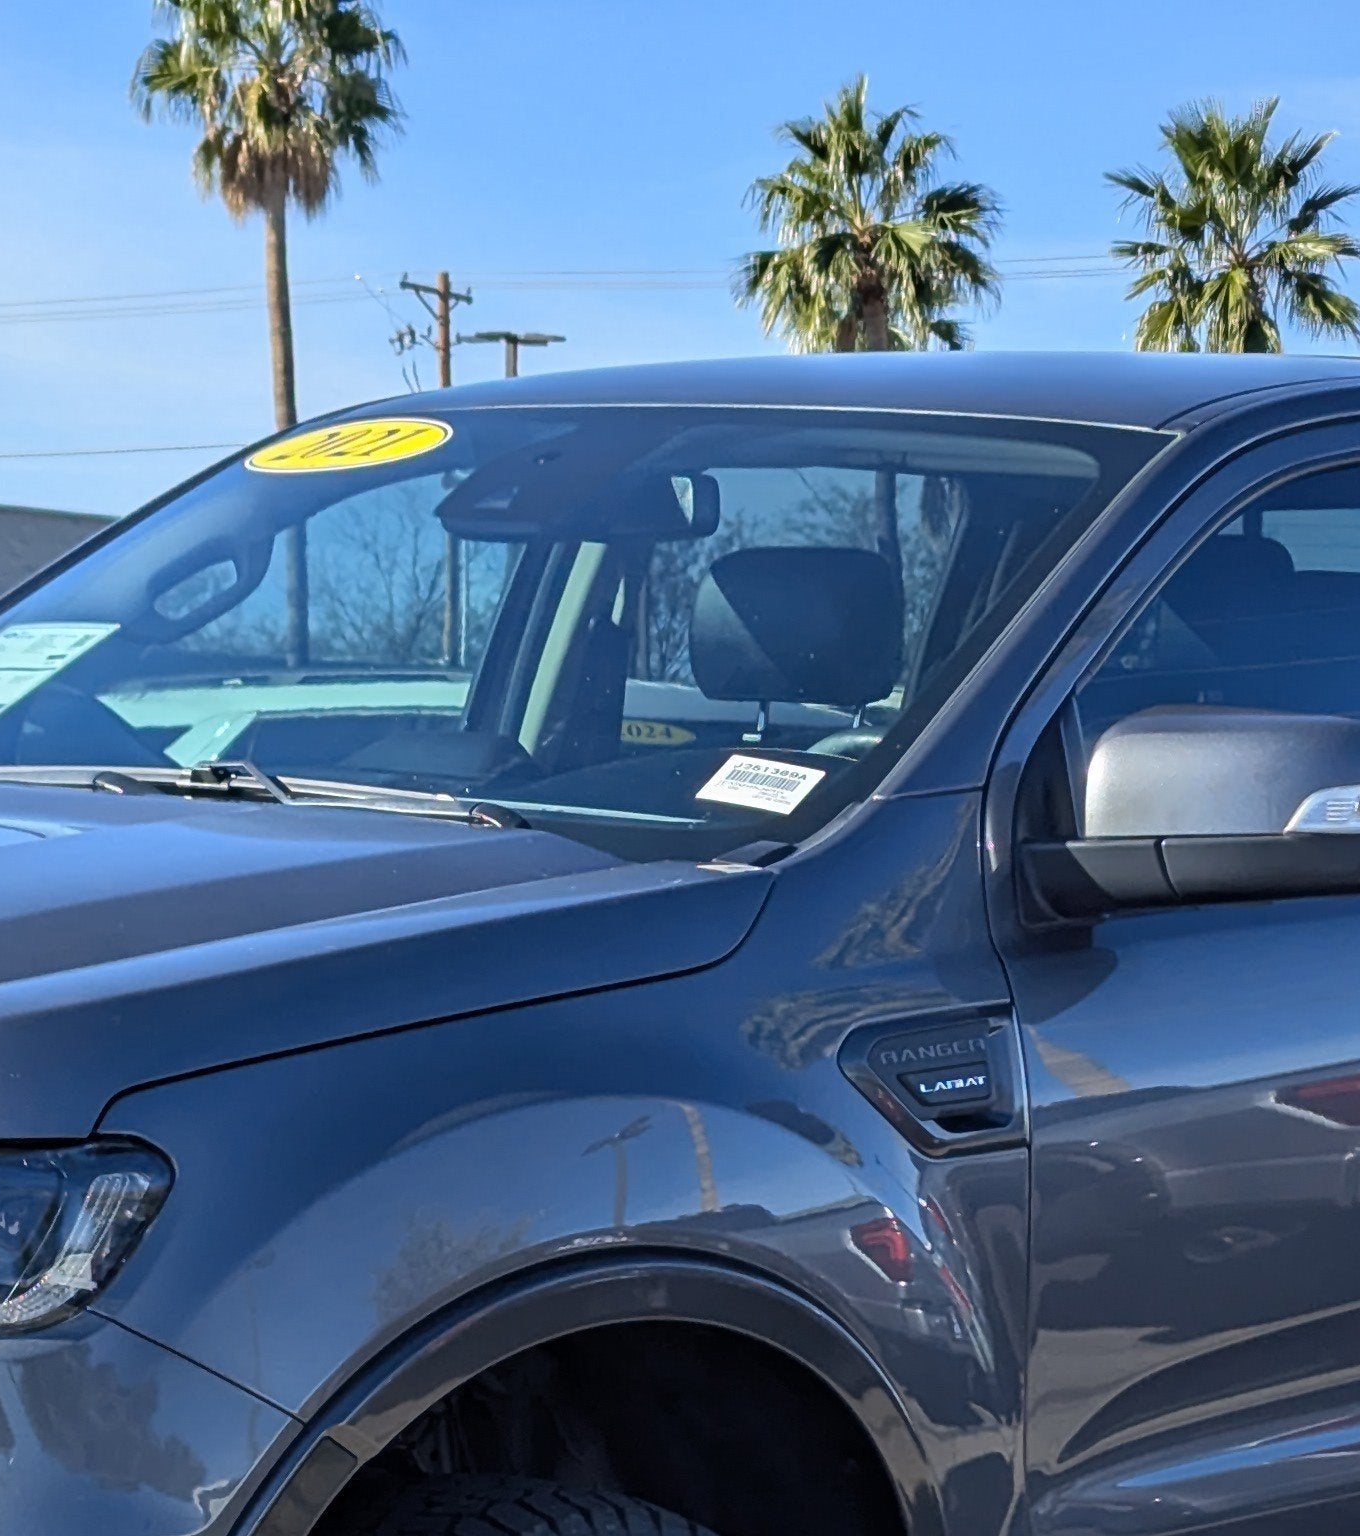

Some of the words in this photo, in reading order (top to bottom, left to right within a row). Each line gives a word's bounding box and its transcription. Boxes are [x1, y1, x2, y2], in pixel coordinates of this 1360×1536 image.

[267, 427, 433, 462] 2021
[621, 724, 673, 739] 024
[879, 1037, 986, 1066] RANGER
